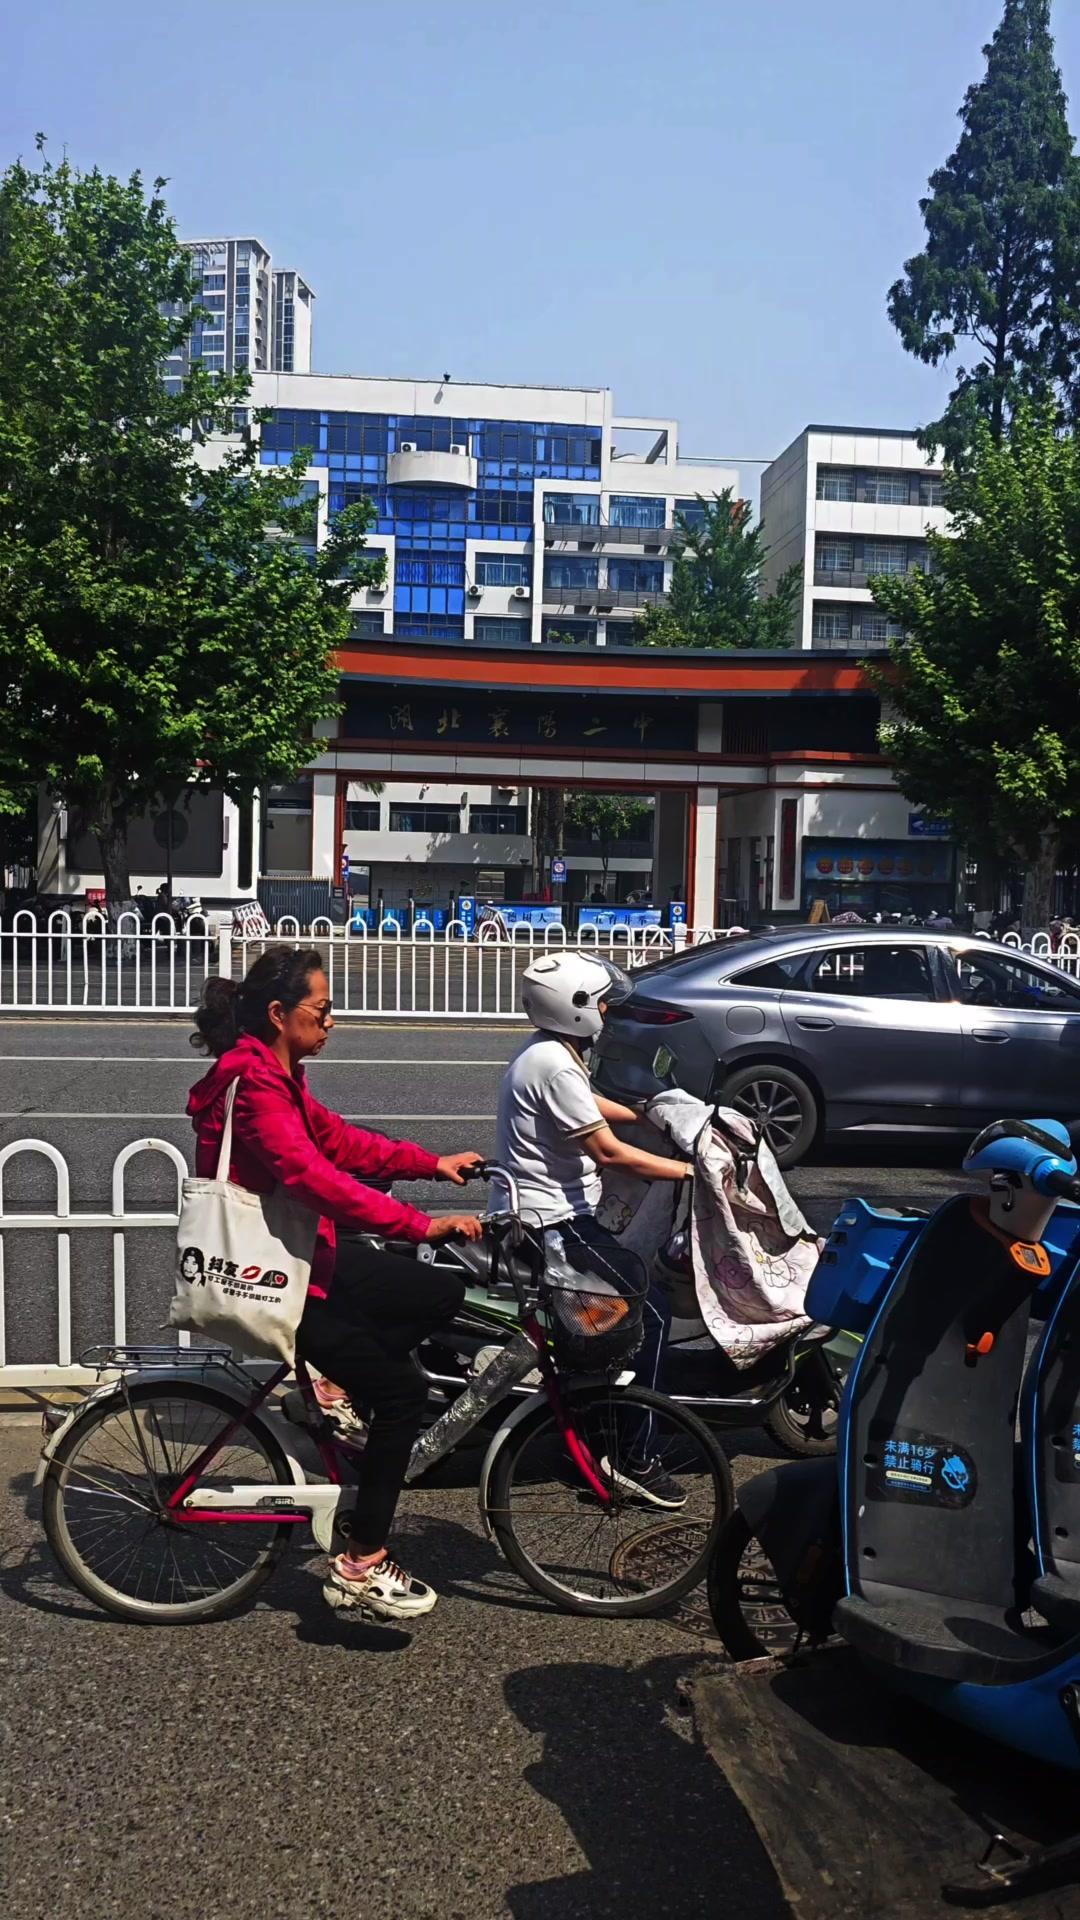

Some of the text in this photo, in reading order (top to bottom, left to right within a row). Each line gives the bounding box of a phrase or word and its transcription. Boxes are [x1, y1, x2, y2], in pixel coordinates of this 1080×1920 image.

[208, 1256, 239, 1278] 抖友
[884, 1440, 938, 1459] 未满16岁
[883, 1454, 935, 1475] 禁止骑行
